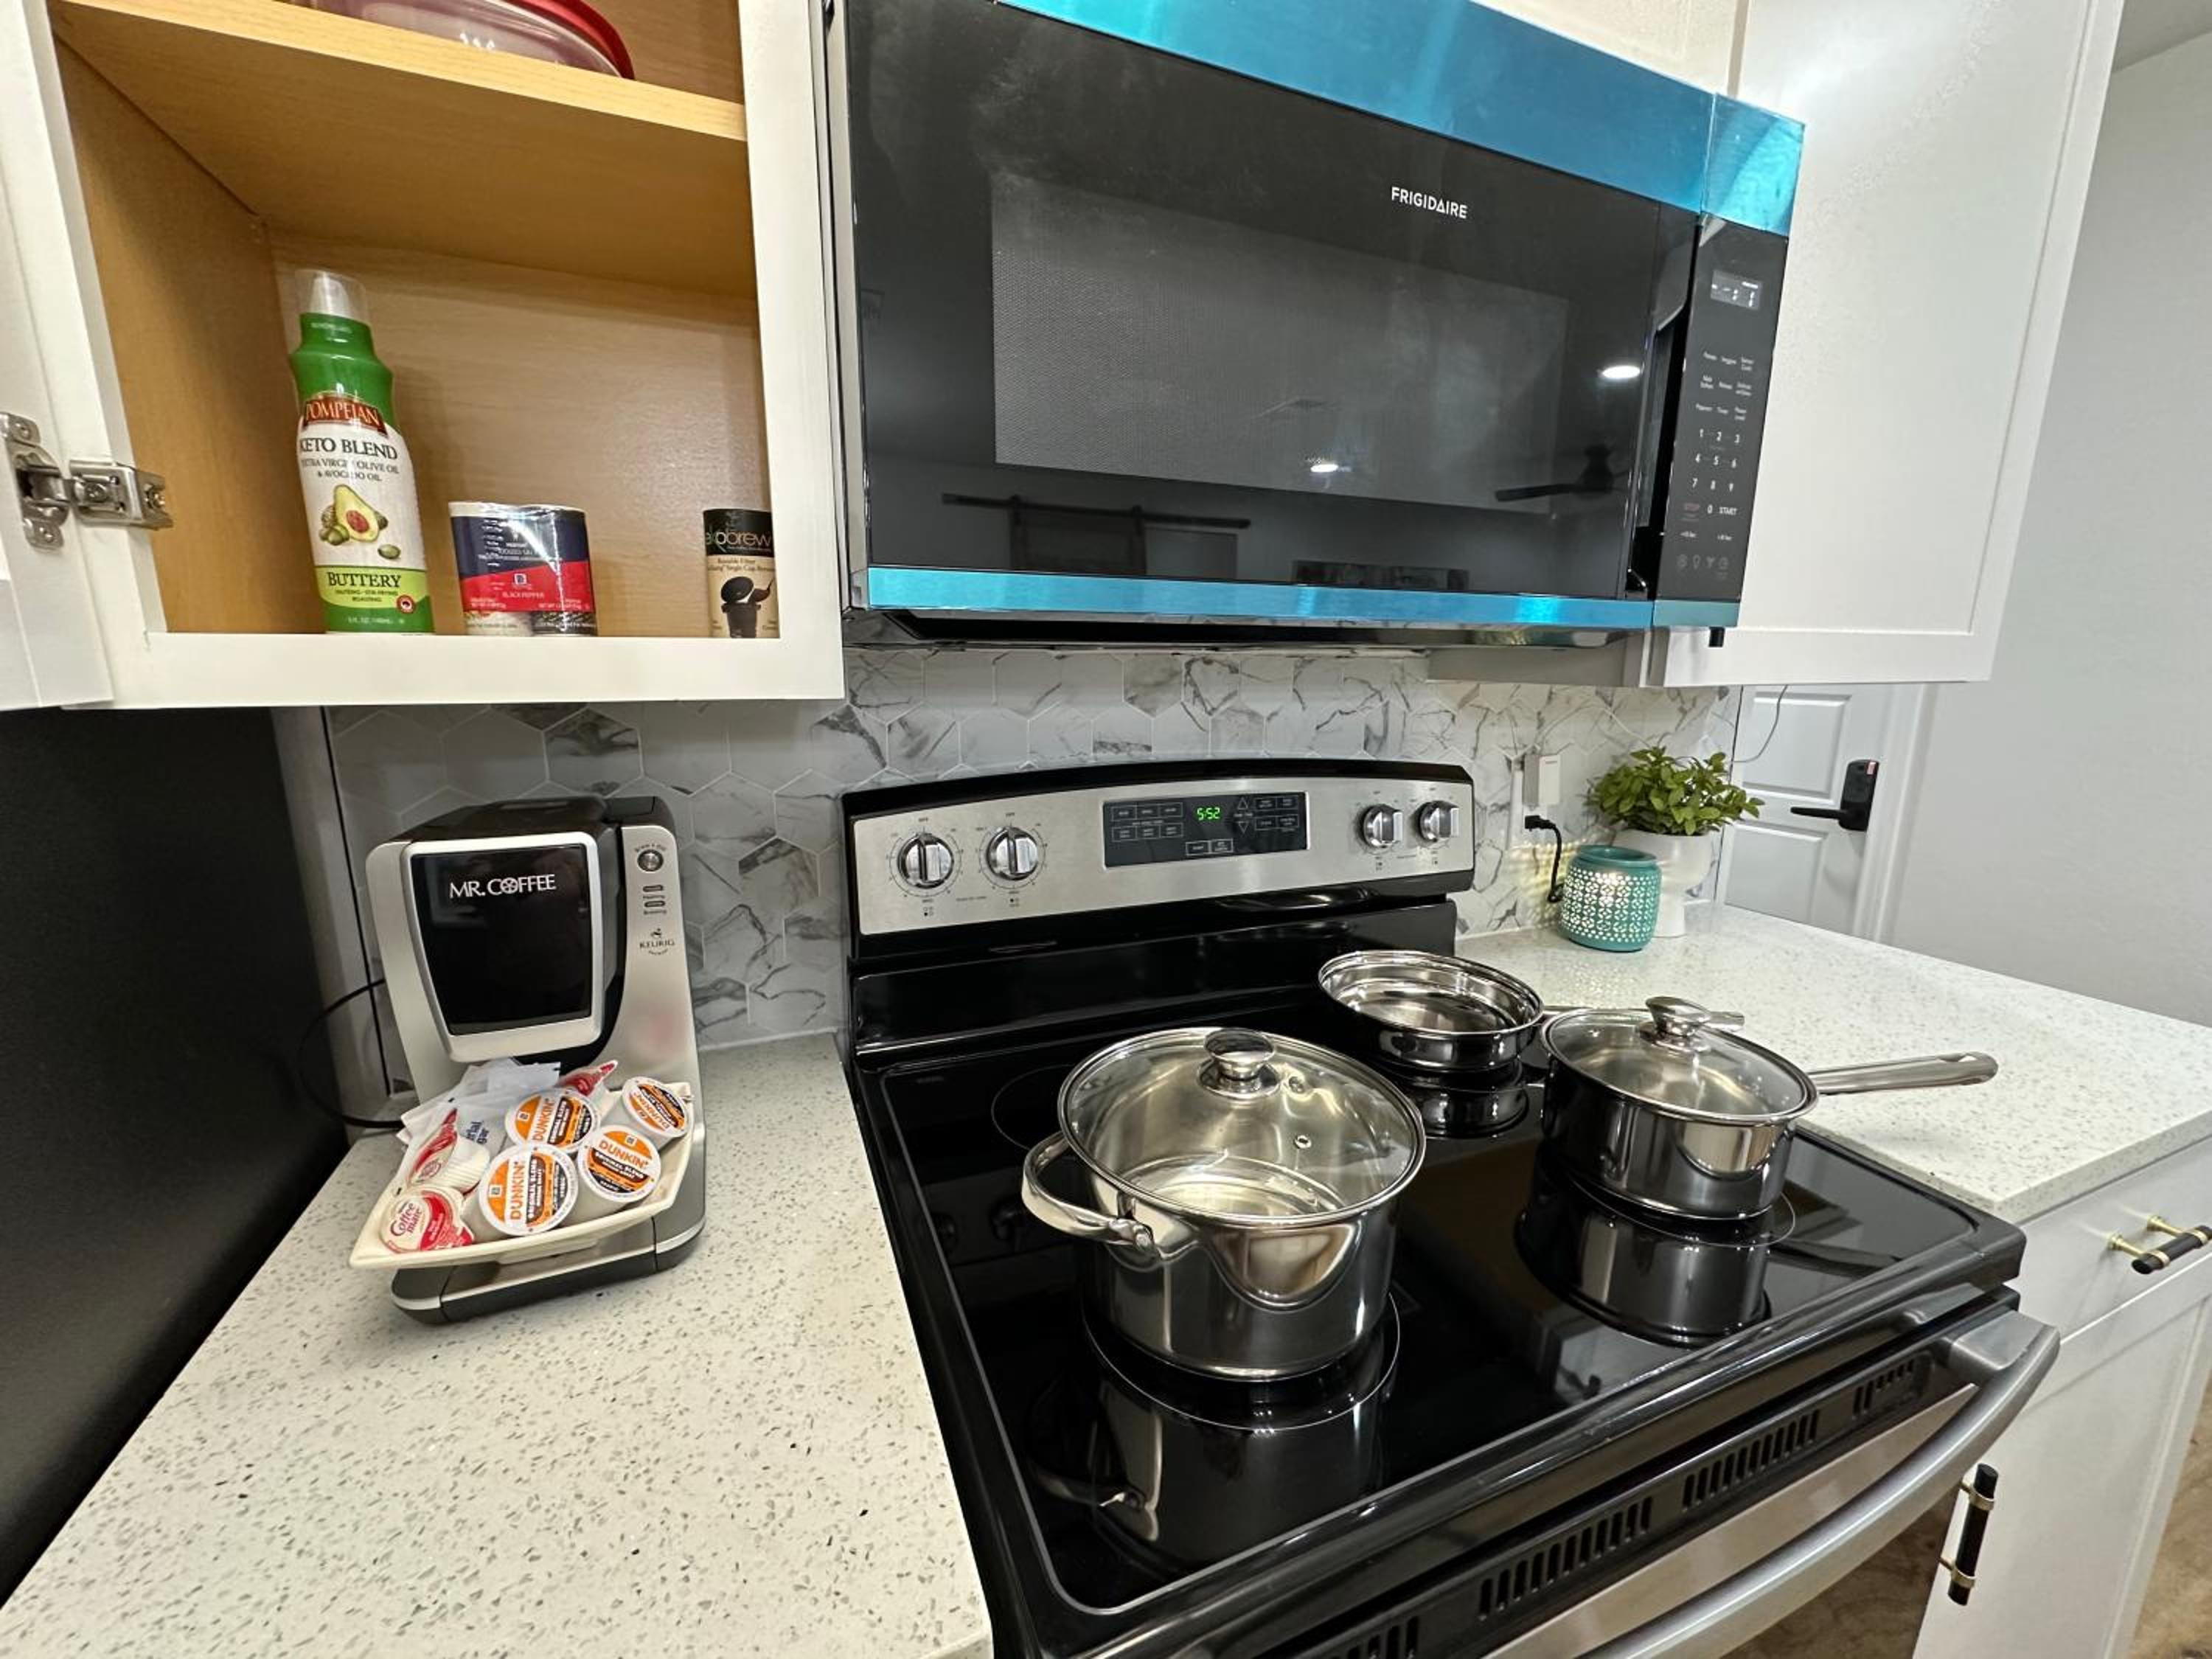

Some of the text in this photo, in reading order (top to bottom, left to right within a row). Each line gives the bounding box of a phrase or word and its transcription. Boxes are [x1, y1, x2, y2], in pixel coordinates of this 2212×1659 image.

[1391, 186, 1468, 219] FRIGIDAIRE
[341, 439, 398, 459] BLEND
[1719, 506, 1738, 515] START
[327, 571, 401, 587] BUTTERY
[1196, 807, 1220, 821] 5:52
[450, 874, 557, 898] MR. COFFEE
[390, 1203, 415, 1237] Coffee
[406, 1208, 422, 1234] mate
